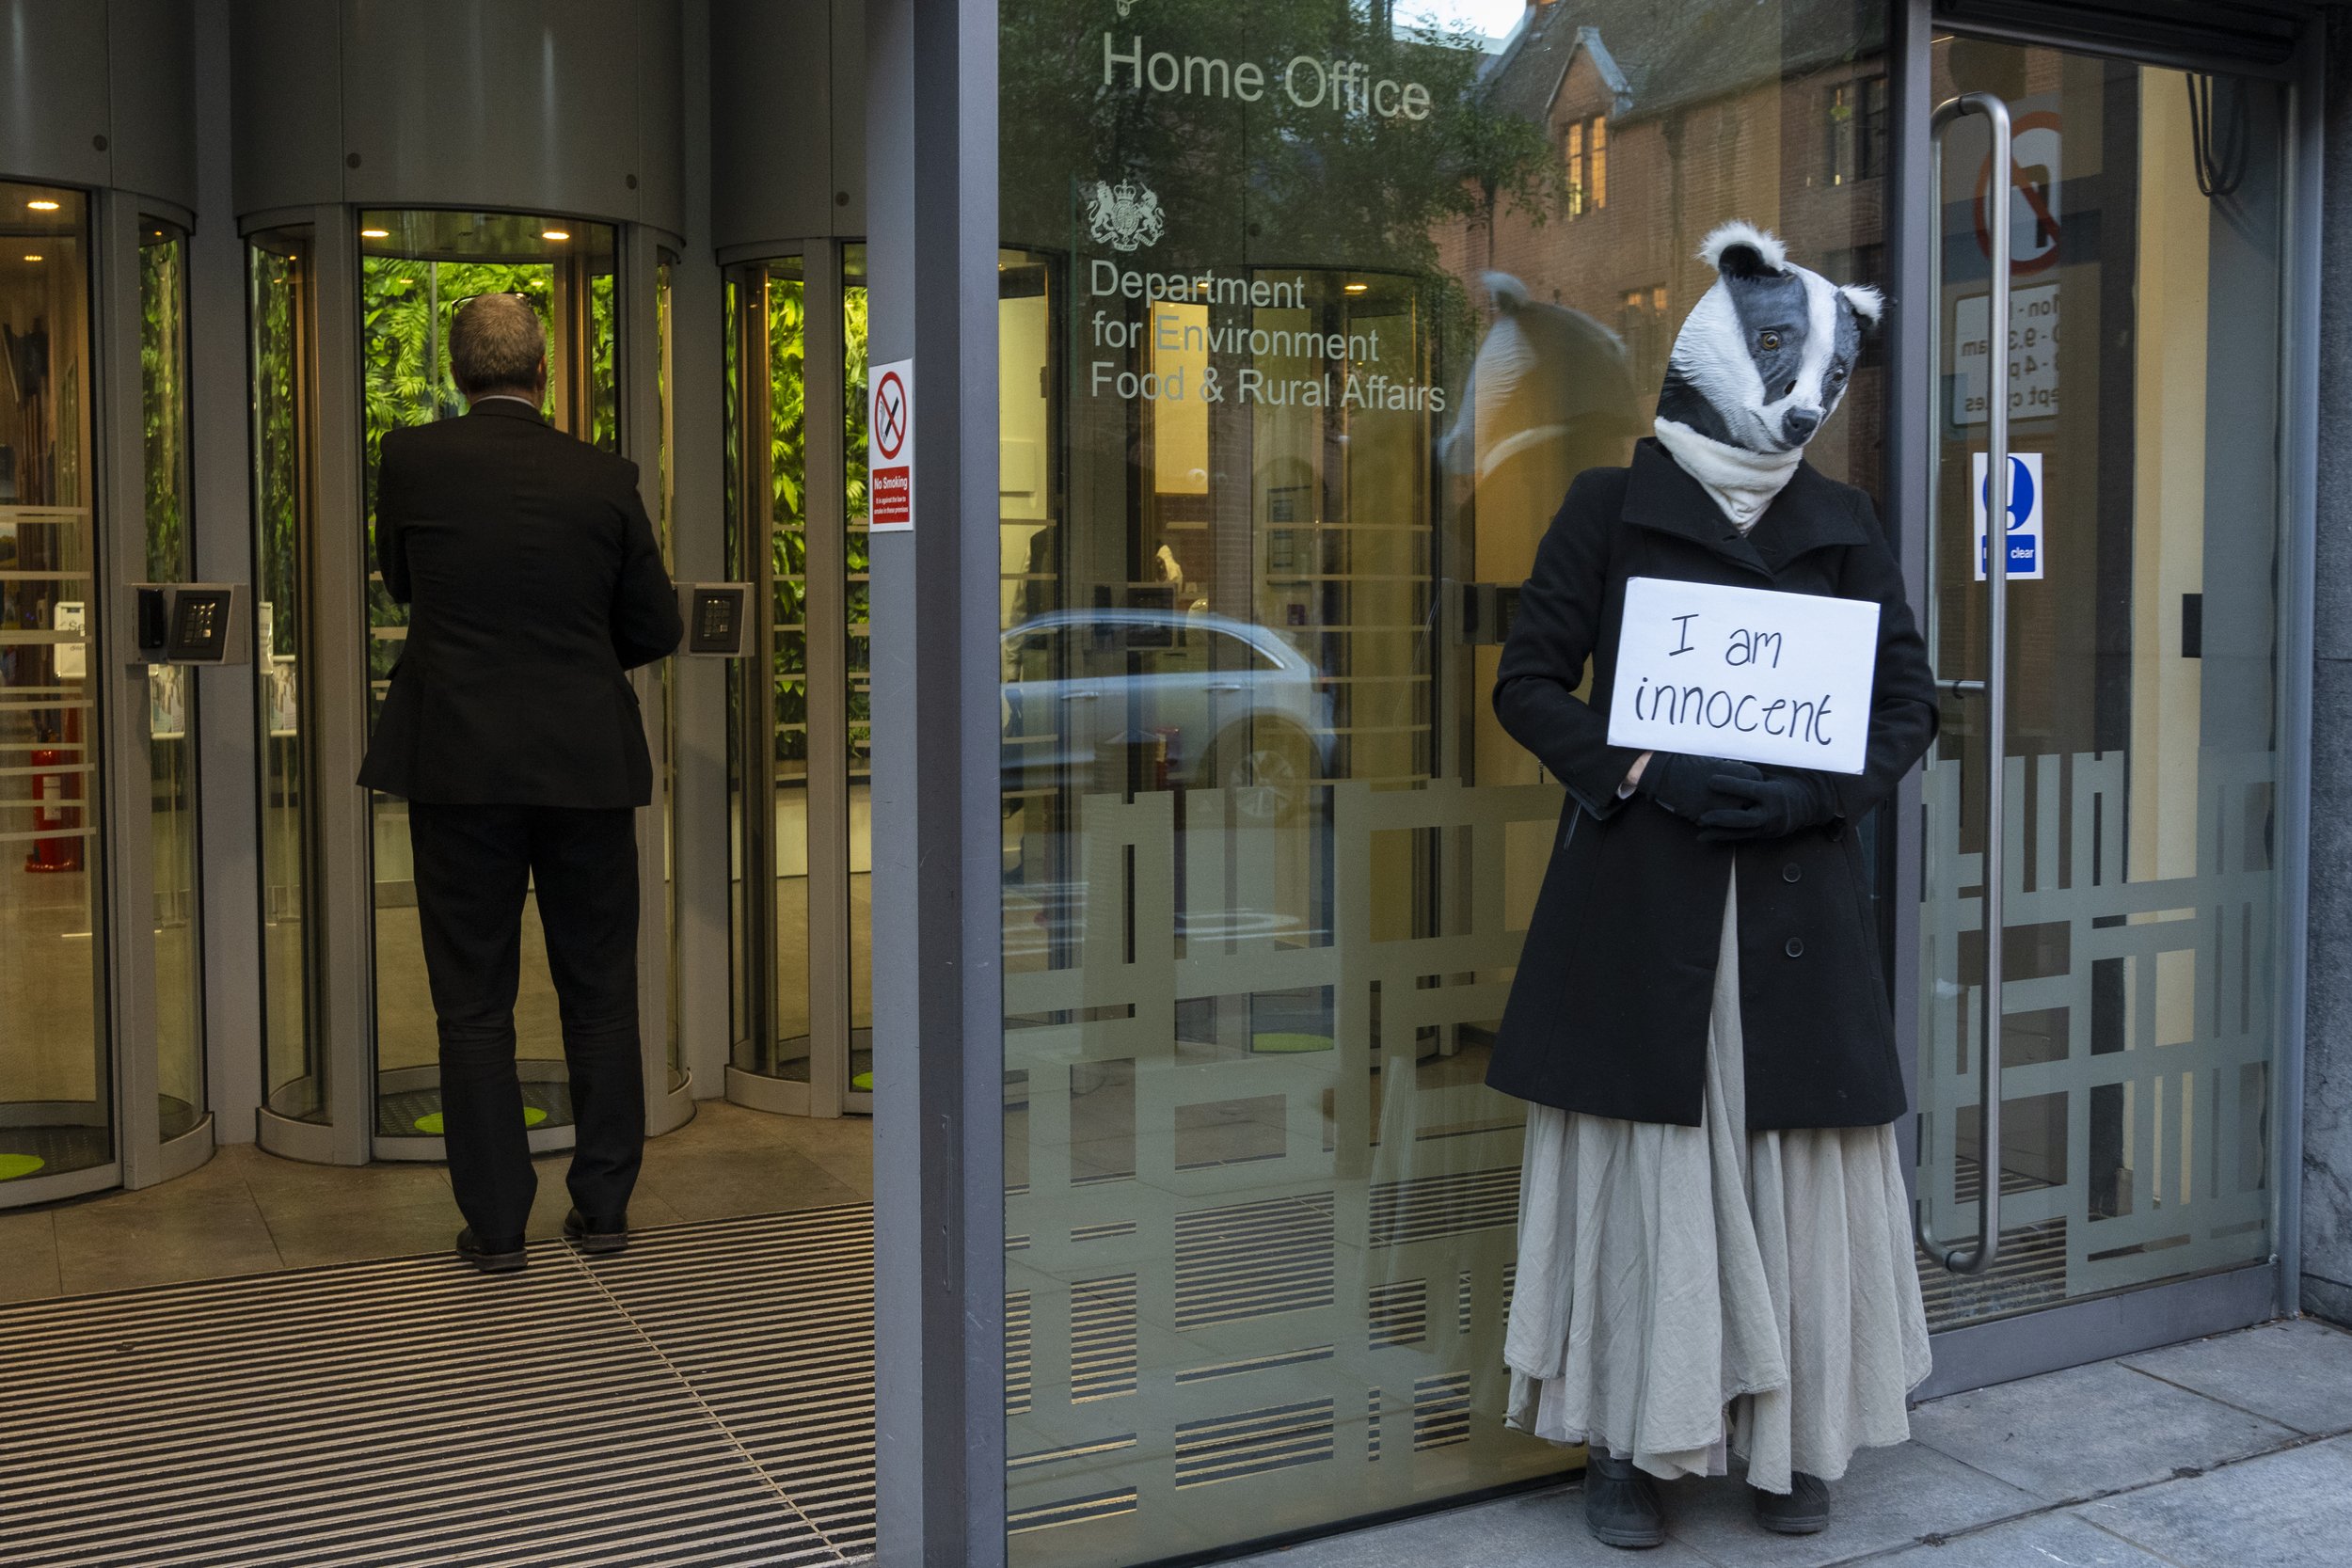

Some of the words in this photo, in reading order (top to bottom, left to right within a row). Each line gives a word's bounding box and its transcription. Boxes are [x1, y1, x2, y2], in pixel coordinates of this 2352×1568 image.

[1104, 31, 1264, 103] Home
[1284, 55, 1431, 121] Office
[1090, 260, 1306, 309] Department
[1091, 310, 1143, 349] for
[1155, 315, 1380, 362] Environment
[1091, 361, 1184, 402] Food
[1200, 366, 1225, 404] &
[1238, 369, 1330, 408] Rural
[1341, 373, 1446, 413] Affairs
[874, 477, 882, 490] No
[883, 475, 908, 491] Smoking
[2010, 546, 2035, 559] clear
[1669, 613, 1699, 657] I
[1725, 628, 1782, 669] am
[1635, 676, 1833, 746] innocent
